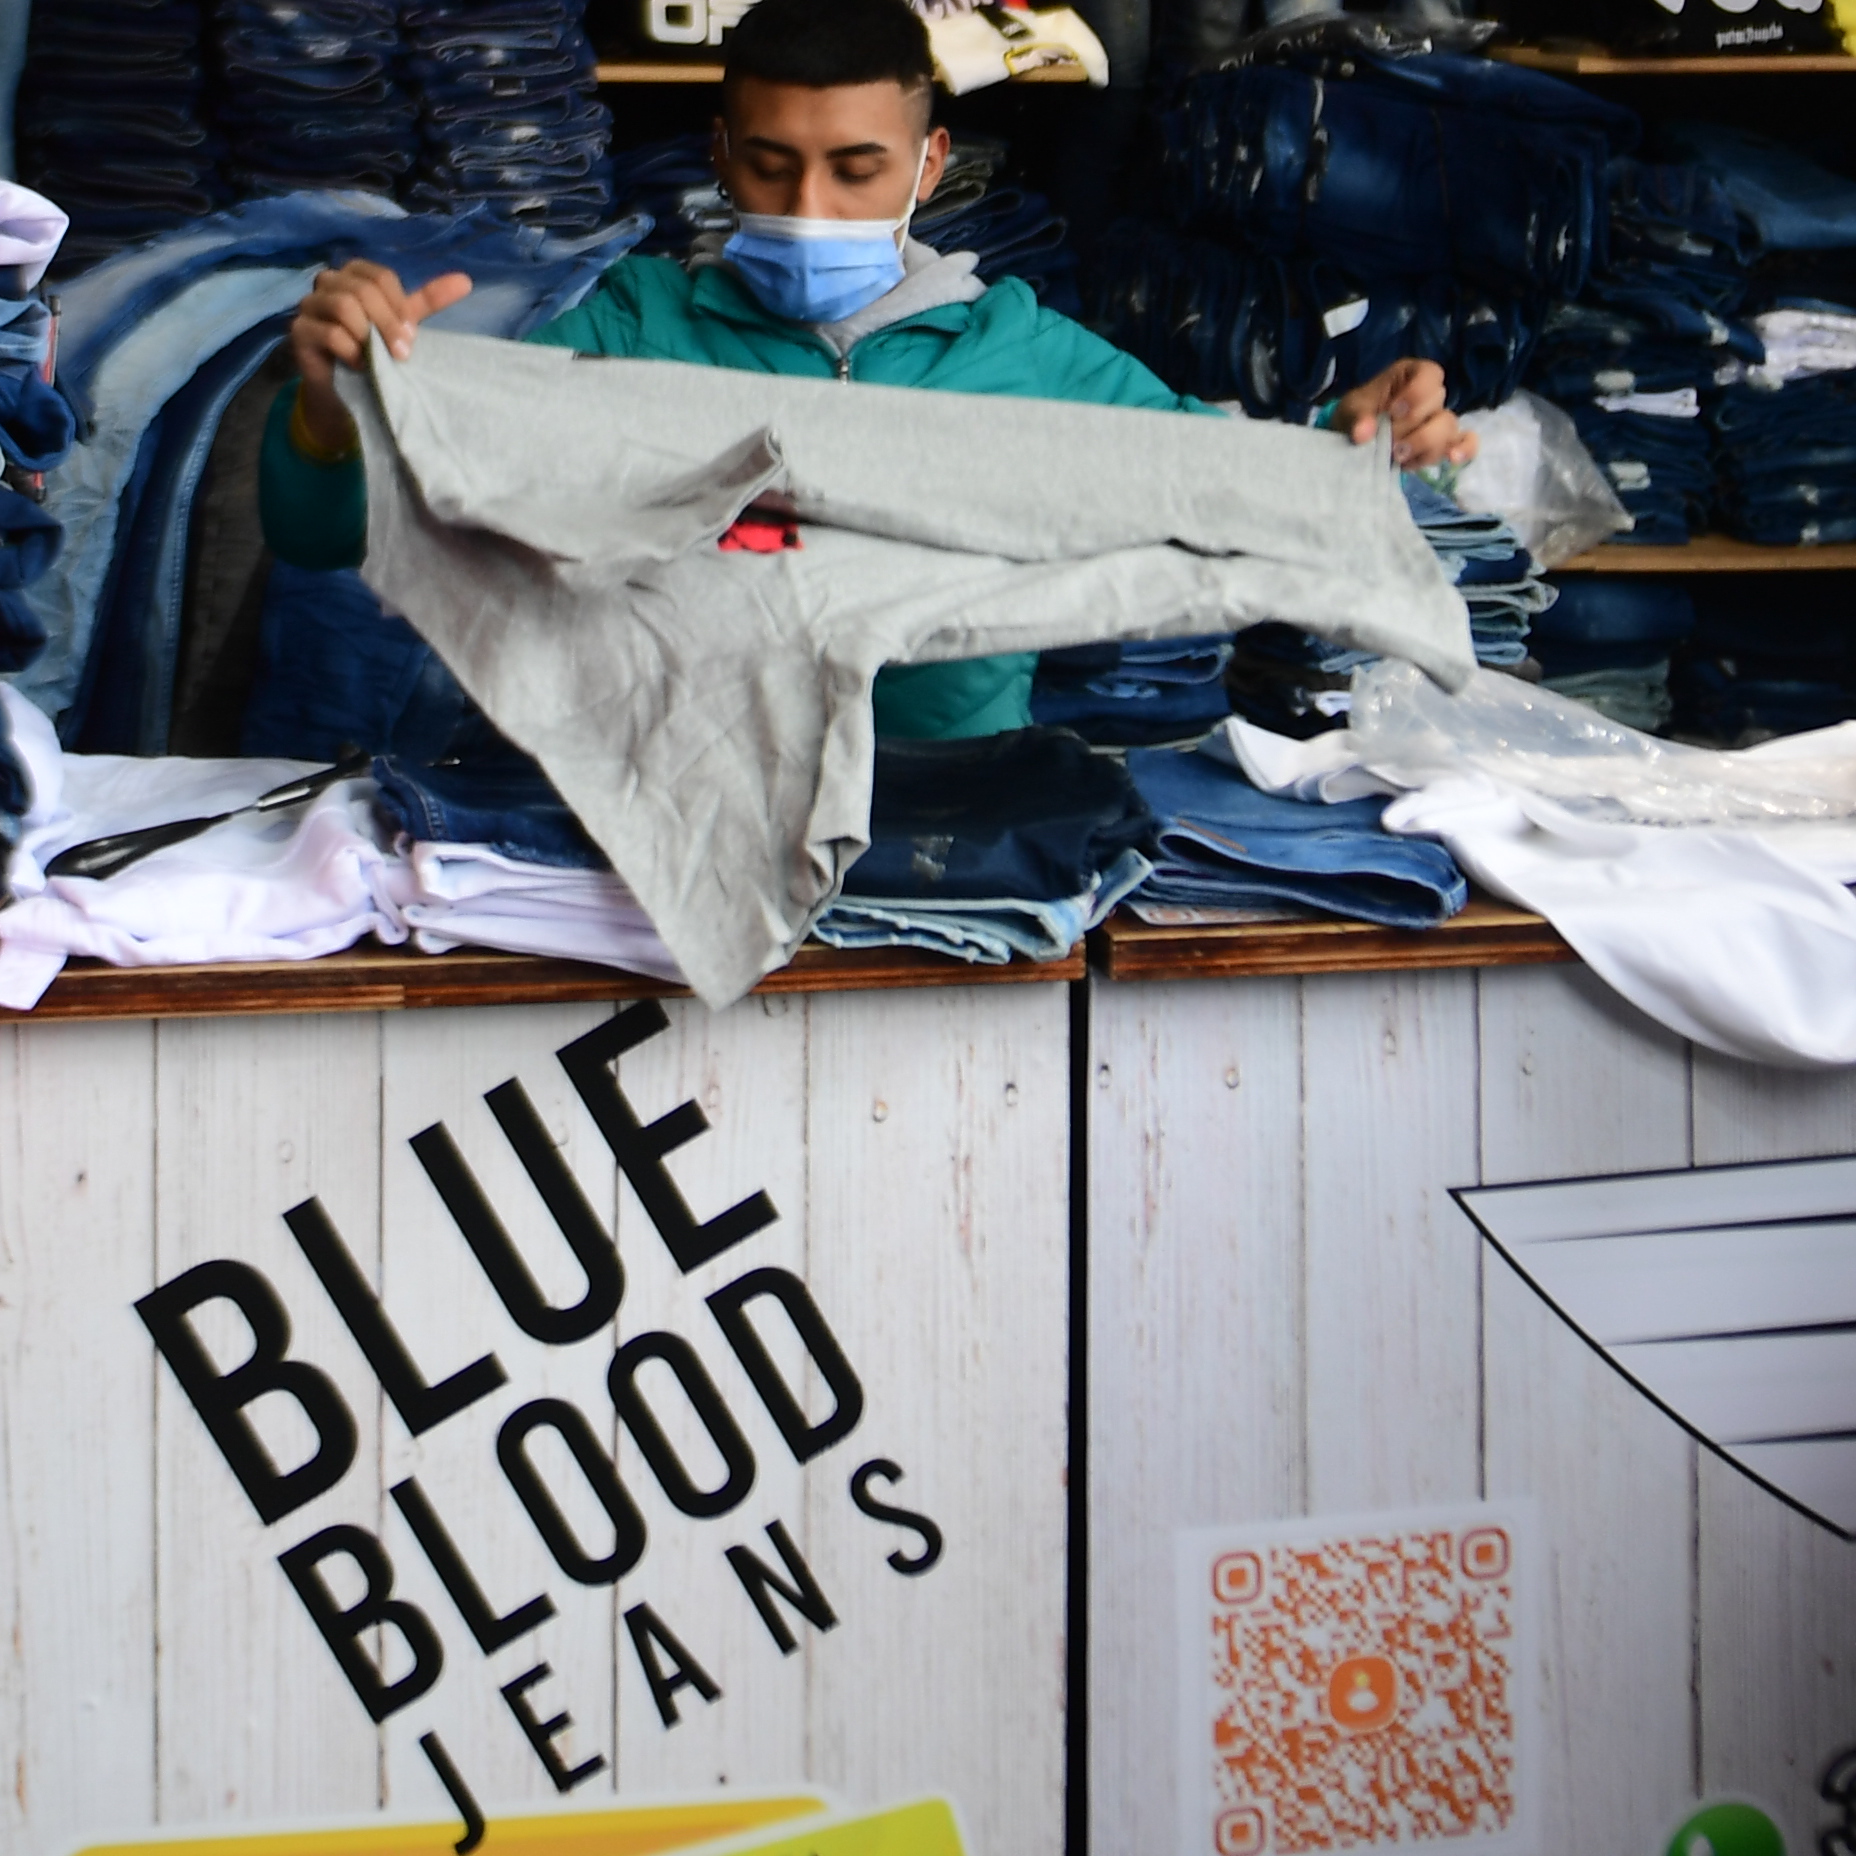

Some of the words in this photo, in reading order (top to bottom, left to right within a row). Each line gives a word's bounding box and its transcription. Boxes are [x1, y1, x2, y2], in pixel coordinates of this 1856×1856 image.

[134, 998, 782, 1527] BLUE
[277, 1266, 864, 1725] BLOOD
[419, 1457, 946, 1856] JEANS
